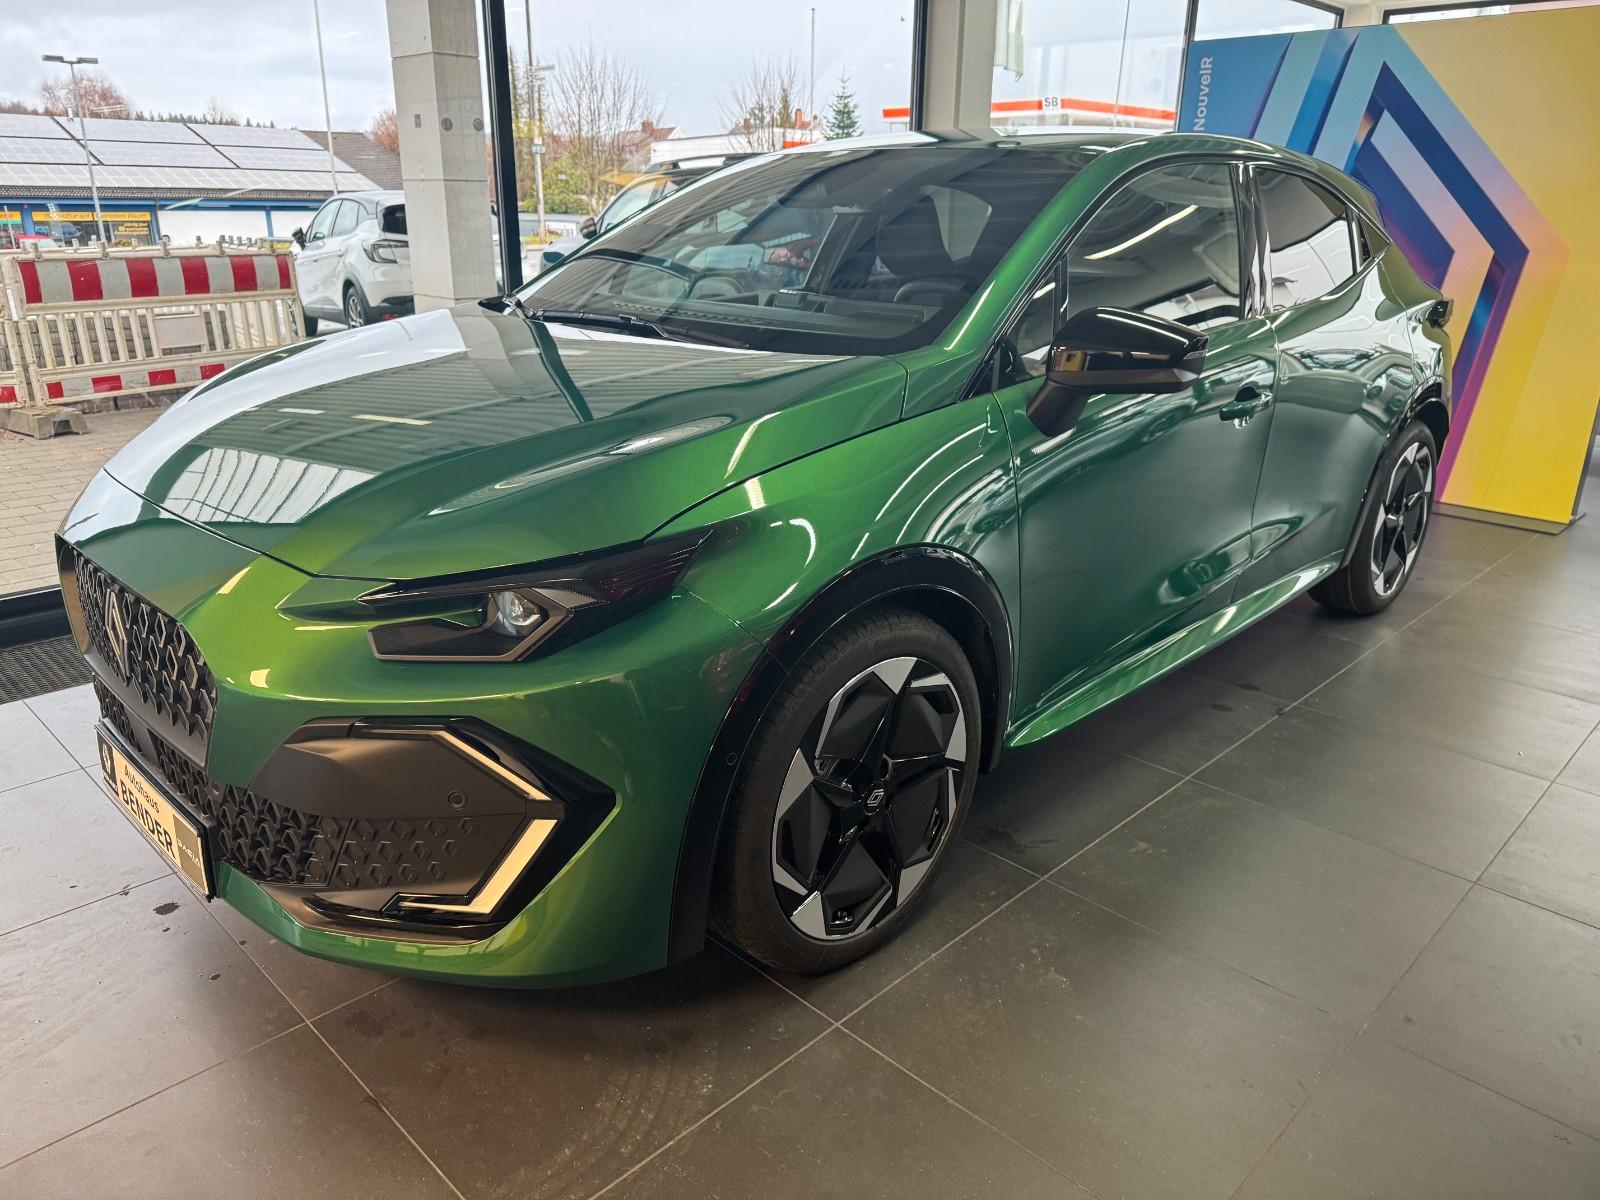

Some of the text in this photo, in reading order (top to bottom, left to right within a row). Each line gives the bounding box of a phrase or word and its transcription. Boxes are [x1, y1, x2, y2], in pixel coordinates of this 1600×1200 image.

[1044, 96, 1058, 107] SB
[1193, 56, 1213, 131] NouvelR
[120, 778, 176, 860] BENDER
[124, 764, 160, 814] Autohaus
